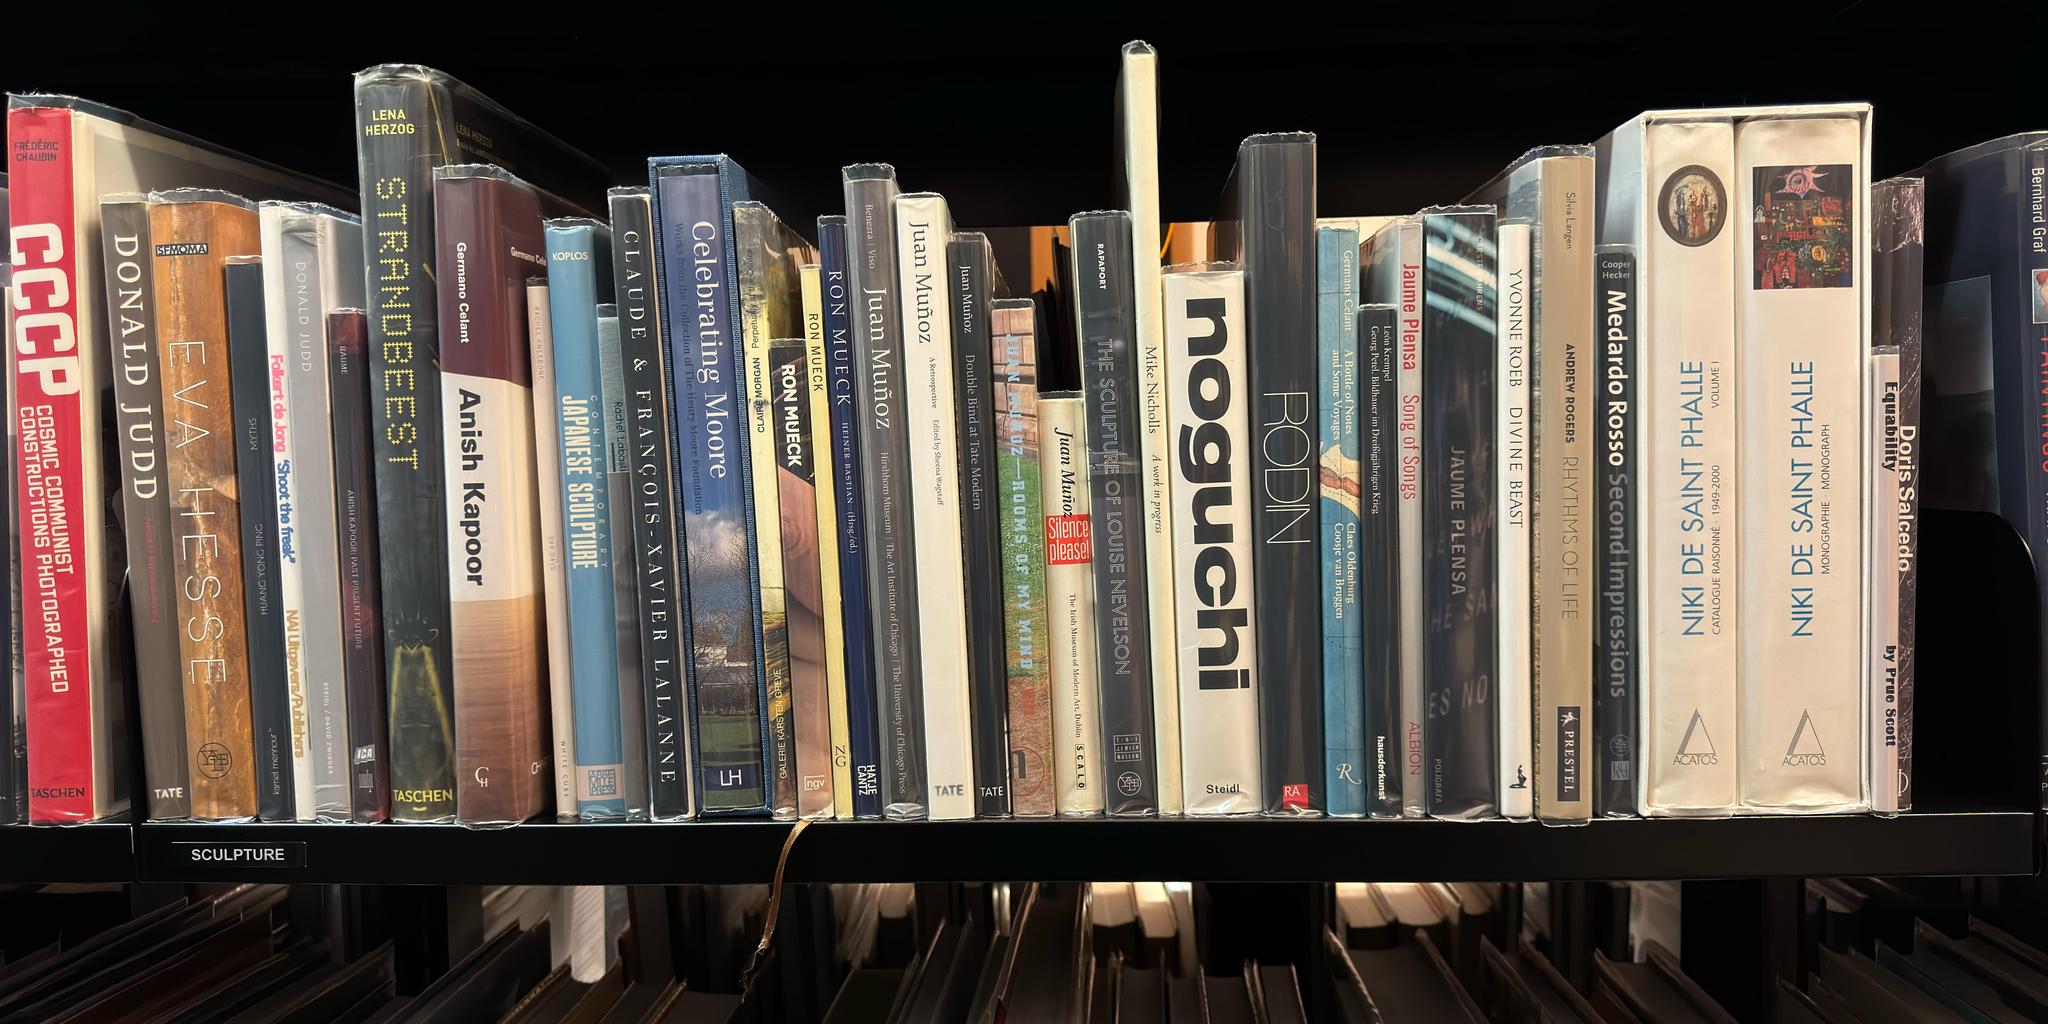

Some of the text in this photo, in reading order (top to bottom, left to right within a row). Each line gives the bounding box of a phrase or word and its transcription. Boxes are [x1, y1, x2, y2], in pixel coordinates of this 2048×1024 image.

[14, 140, 59, 152] FRÉDÉRIC
[16, 153, 57, 163] CHAUBIN
[365, 123, 415, 137] HERZOG
[372, 110, 406, 121] LENA
[157, 244, 209, 257] SFMOMA
[552, 252, 588, 261] KOPLOS
[1563, 192, 1576, 250] Silvia Langen
[2031, 167, 2046, 252] Bernhard Graf
[10, 223, 80, 397] CCCP
[114, 234, 148, 386] DONALD
[456, 242, 471, 344] Germano Celant
[907, 222, 934, 344] Juan Muñoz
[1097, 243, 1107, 290] RAPAPORT
[1342, 250, 1355, 331] Germano Celant
[295, 263, 312, 372] DONALD JUDD
[376, 177, 418, 470] STRANDBEEST
[692, 221, 729, 479] Celebrating Moore
[808, 313, 823, 392] RON MUECK
[828, 270, 850, 406] RON MUECK
[863, 287, 894, 430] Juan Muñoz
[1381, 325, 1393, 382] León Krempel
[1402, 264, 1420, 370] Jaume Plensa
[1509, 269, 1523, 387] YVONNE ROEB
[271, 355, 288, 452] Folkert de Jong
[752, 357, 765, 434] CLAIRE MORGAN
[780, 365, 803, 468] RON MUECK
[959, 265, 983, 510] Juan Muñoz Double Bind at Tate Modern
[1146, 346, 1159, 434] Mike Nicholls
[1330, 349, 1344, 441] and Some Voyages
[1344, 349, 1355, 435] A Bottle of Notes
[1369, 326, 1382, 515] Georg Petel. Bildhauer im Dreißigjährigen Krieg
[1565, 343, 1576, 443] ANDREW ROGERS
[36, 404, 75, 575] COSMIC COMMUNIST
[121, 404, 157, 500] JUDD
[458, 389, 485, 587] Anish Kapoor
[562, 396, 598, 569] JAPANESE SCULPTURE
[1054, 428, 1077, 518] Juan Muñoz
[1150, 455, 1163, 534] A work in progress
[1179, 297, 1250, 691] noguchi
[1263, 392, 1311, 544] RODIN
[1399, 395, 1420, 501] Song of Songs
[1509, 407, 1523, 529] DIVINE BEAST
[1604, 290, 1630, 697] Medardo Rosso Second Impressions
[169, 341, 226, 685] EVA HESSE
[623, 231, 676, 784] CLAUDE & FRANÇOIS-XAVIER LALANNE
[1048, 518, 1088, 537] Silence
[1098, 338, 1129, 675] THE SCULPTURE OF LOUISE NEVELSON
[1450, 446, 1466, 595] JAUME PLENSA
[1561, 456, 1579, 621] RHYTHMS OF LIFE
[1680, 361, 1704, 636] NIKI DE SAINT PHALLE
[1790, 361, 1813, 637] NIKI DE SAINT PHALLE
[1821, 424, 1830, 575] MONOGRAPHIE MONOGRAPH
[1898, 426, 1916, 573] Doris Salcedo
[19, 406, 70, 694] CONSTRUCTIONS PHOTOGRAPHED
[1049, 544, 1090, 562] please!
[1333, 523, 1345, 619] Coosje van Bruggen
[1345, 522, 1358, 603] Claes Oldenburg
[1711, 465, 1721, 635] CATALOGUE RAISONNÉ 1949-2000
[1882, 381, 1897, 746] Equability by Prue Scott
[30, 787, 86, 798] TASCHEN
[153, 788, 184, 799] TATE
[393, 790, 453, 801] TASCHEN
[857, 765, 868, 796] CANTZ
[866, 764, 877, 795] HATJE
[934, 785, 964, 796] TATE
[979, 787, 1004, 797] TATE
[1206, 785, 1240, 794] Steidl
[1377, 735, 1387, 801] hausderkunst
[1408, 721, 1422, 776] ALBION
[1564, 730, 1575, 794] PRESTEL
[1672, 755, 1718, 766] ACATOS
[1781, 755, 1827, 767] ACATOS
[191, 848, 285, 862] SCULPTURE
